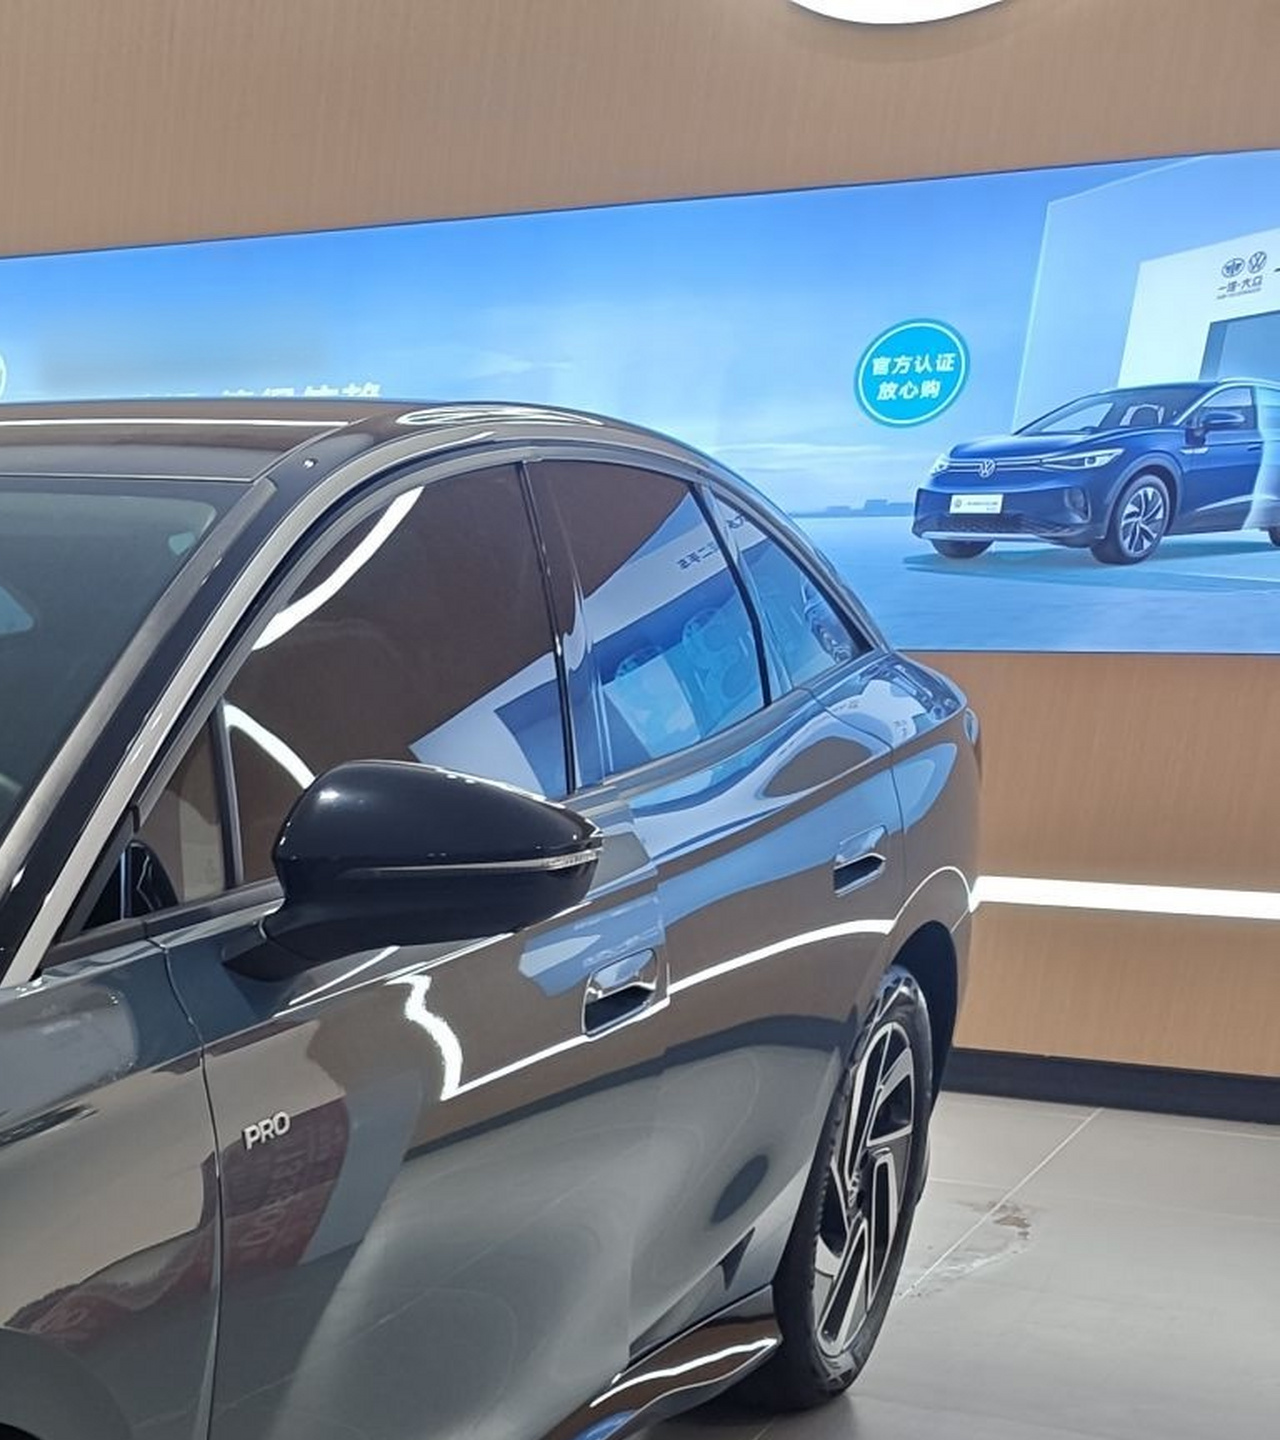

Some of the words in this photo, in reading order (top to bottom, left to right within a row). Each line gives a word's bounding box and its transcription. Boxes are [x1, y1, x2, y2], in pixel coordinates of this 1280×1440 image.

[872, 353, 956, 376] 官方认证
[877, 379, 941, 401] 放心购
[243, 1111, 290, 1150] PRO
